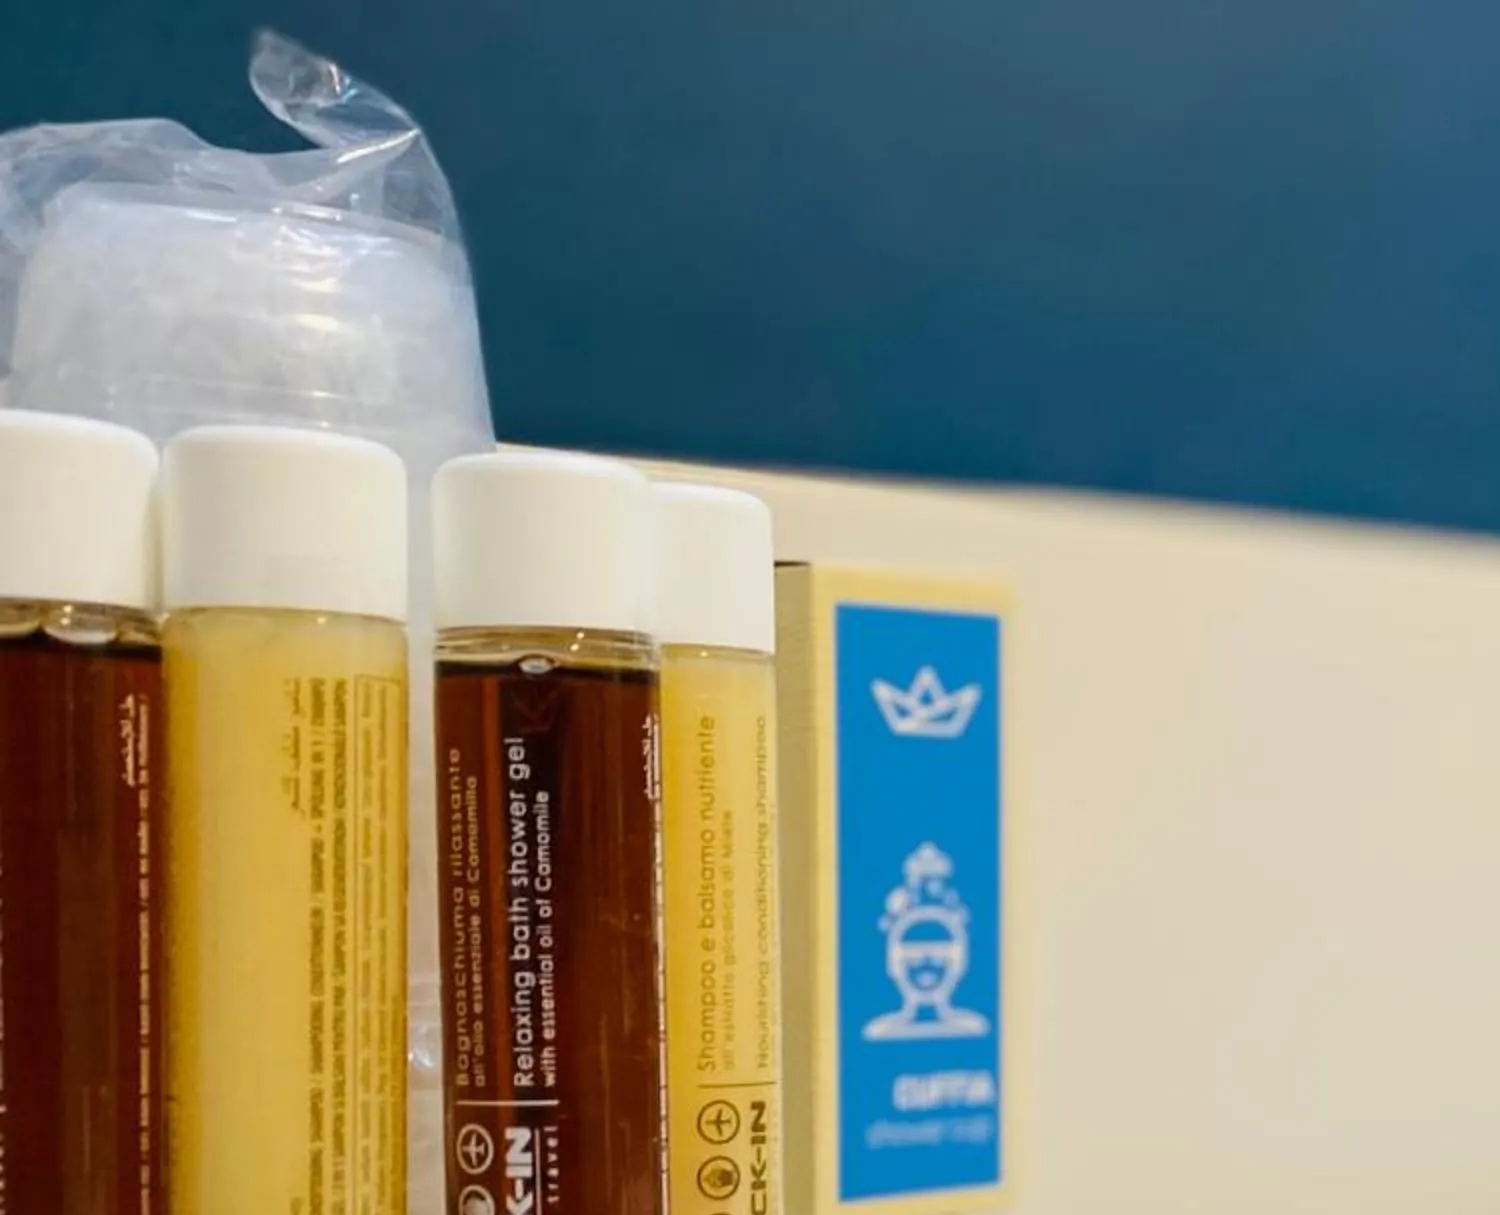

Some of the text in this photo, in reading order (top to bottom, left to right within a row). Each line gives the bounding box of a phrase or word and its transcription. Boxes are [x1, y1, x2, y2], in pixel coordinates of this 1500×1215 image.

[753, 715, 769, 814] shampoo
[448, 748, 471, 1086] Bagnoschiuma rilassante
[466, 889, 481, 907] di
[503, 737, 536, 1087] Relaxing bath shower gel
[533, 790, 557, 1087] with essential oil of Camomile
[696, 715, 719, 1072] Shampoo e balsamo nutriente
[754, 823, 772, 955] conditioning
[467, 915, 483, 1014] essenziale
[544, 1126, 559, 1202] travel
